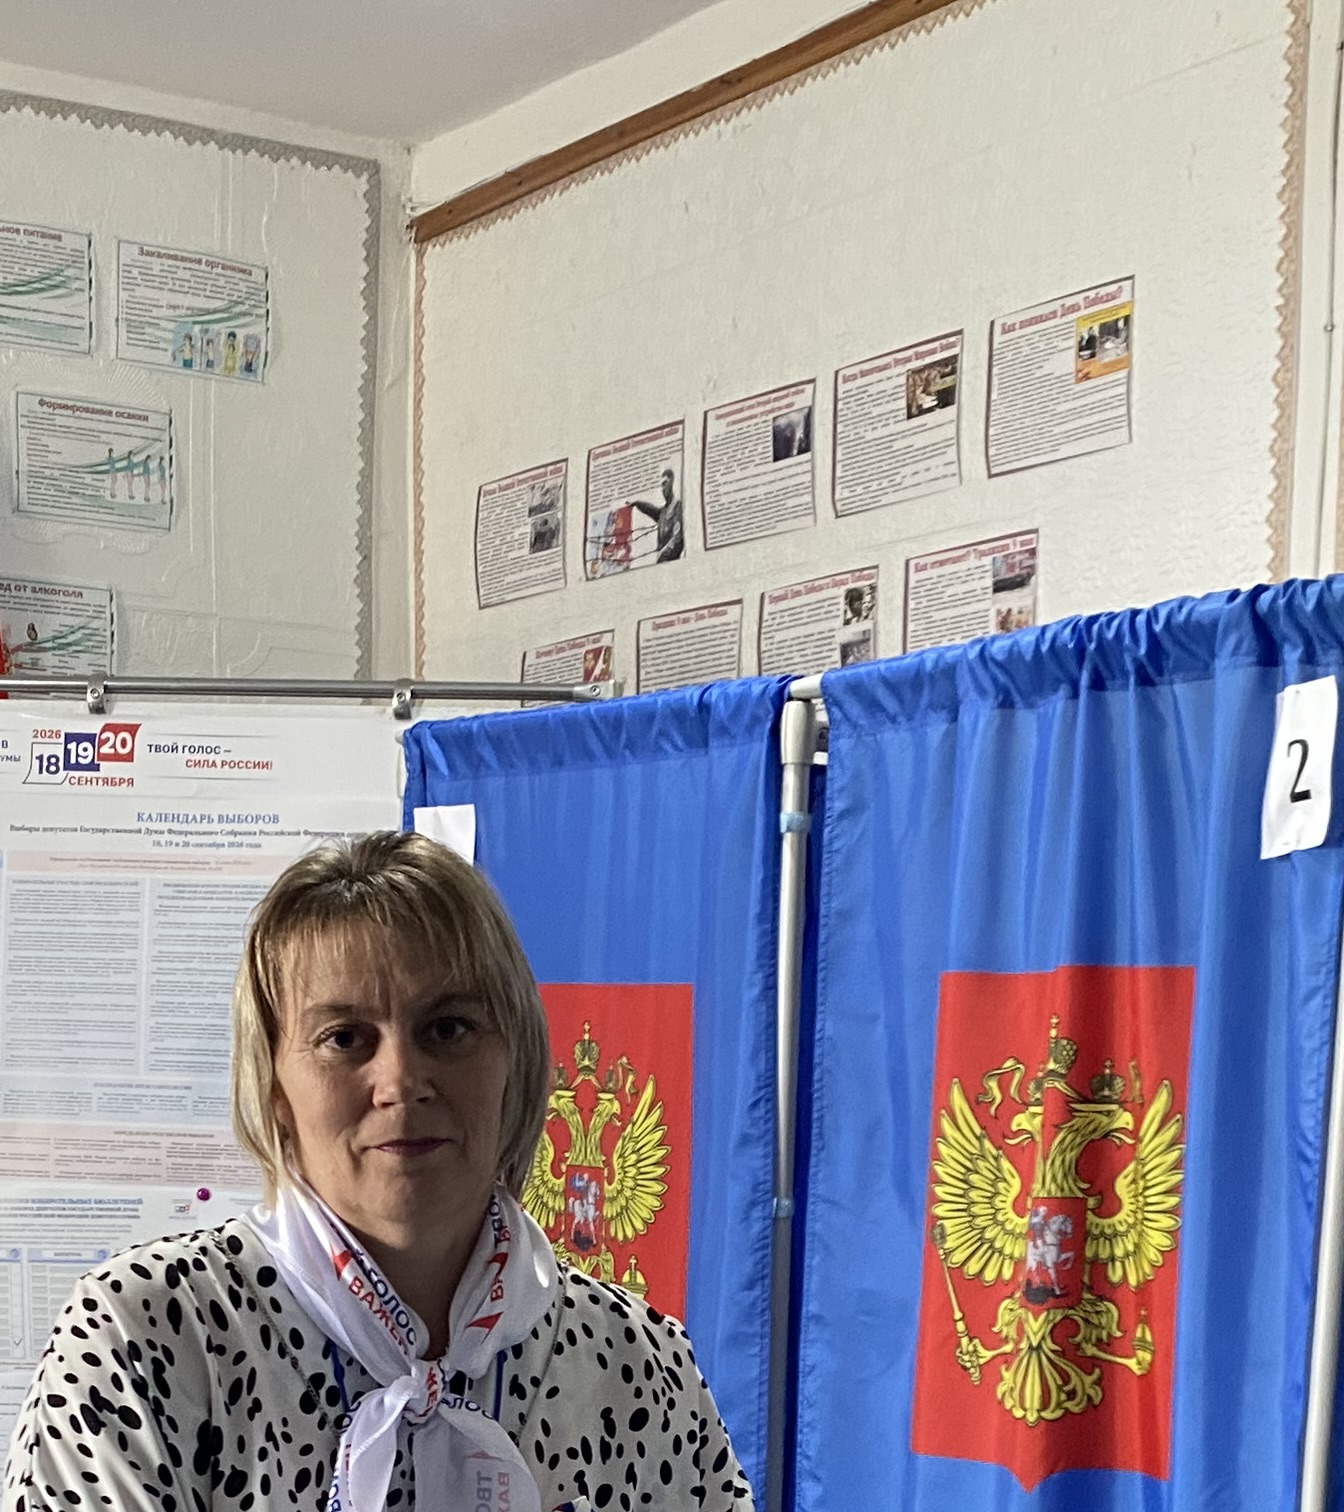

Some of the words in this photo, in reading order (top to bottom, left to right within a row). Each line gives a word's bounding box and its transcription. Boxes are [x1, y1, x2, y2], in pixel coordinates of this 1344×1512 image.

[38, 397, 113, 419] Формирование
[115, 409, 149, 423] осанки
[14, 584, 27, 594] от
[30, 585, 83, 599] алкоголя
[32, 728, 62, 740] 2026
[99, 731, 131, 754] 20
[147, 741, 178, 755] ТВОЙ
[181, 744, 221, 755] ГОЛОС
[67, 742, 94, 765] 19
[35, 753, 60, 776] 18
[186, 758, 219, 769] СИЛА
[222, 758, 273, 770] РОССИИ!
[1287, 738, 1312, 803] 2
[68, 775, 135, 788] СЕНТЯБРЯ
[136, 811, 214, 825] КАЛЕНДАРЬ
[216, 813, 280, 825] ВЫБОРОВ
